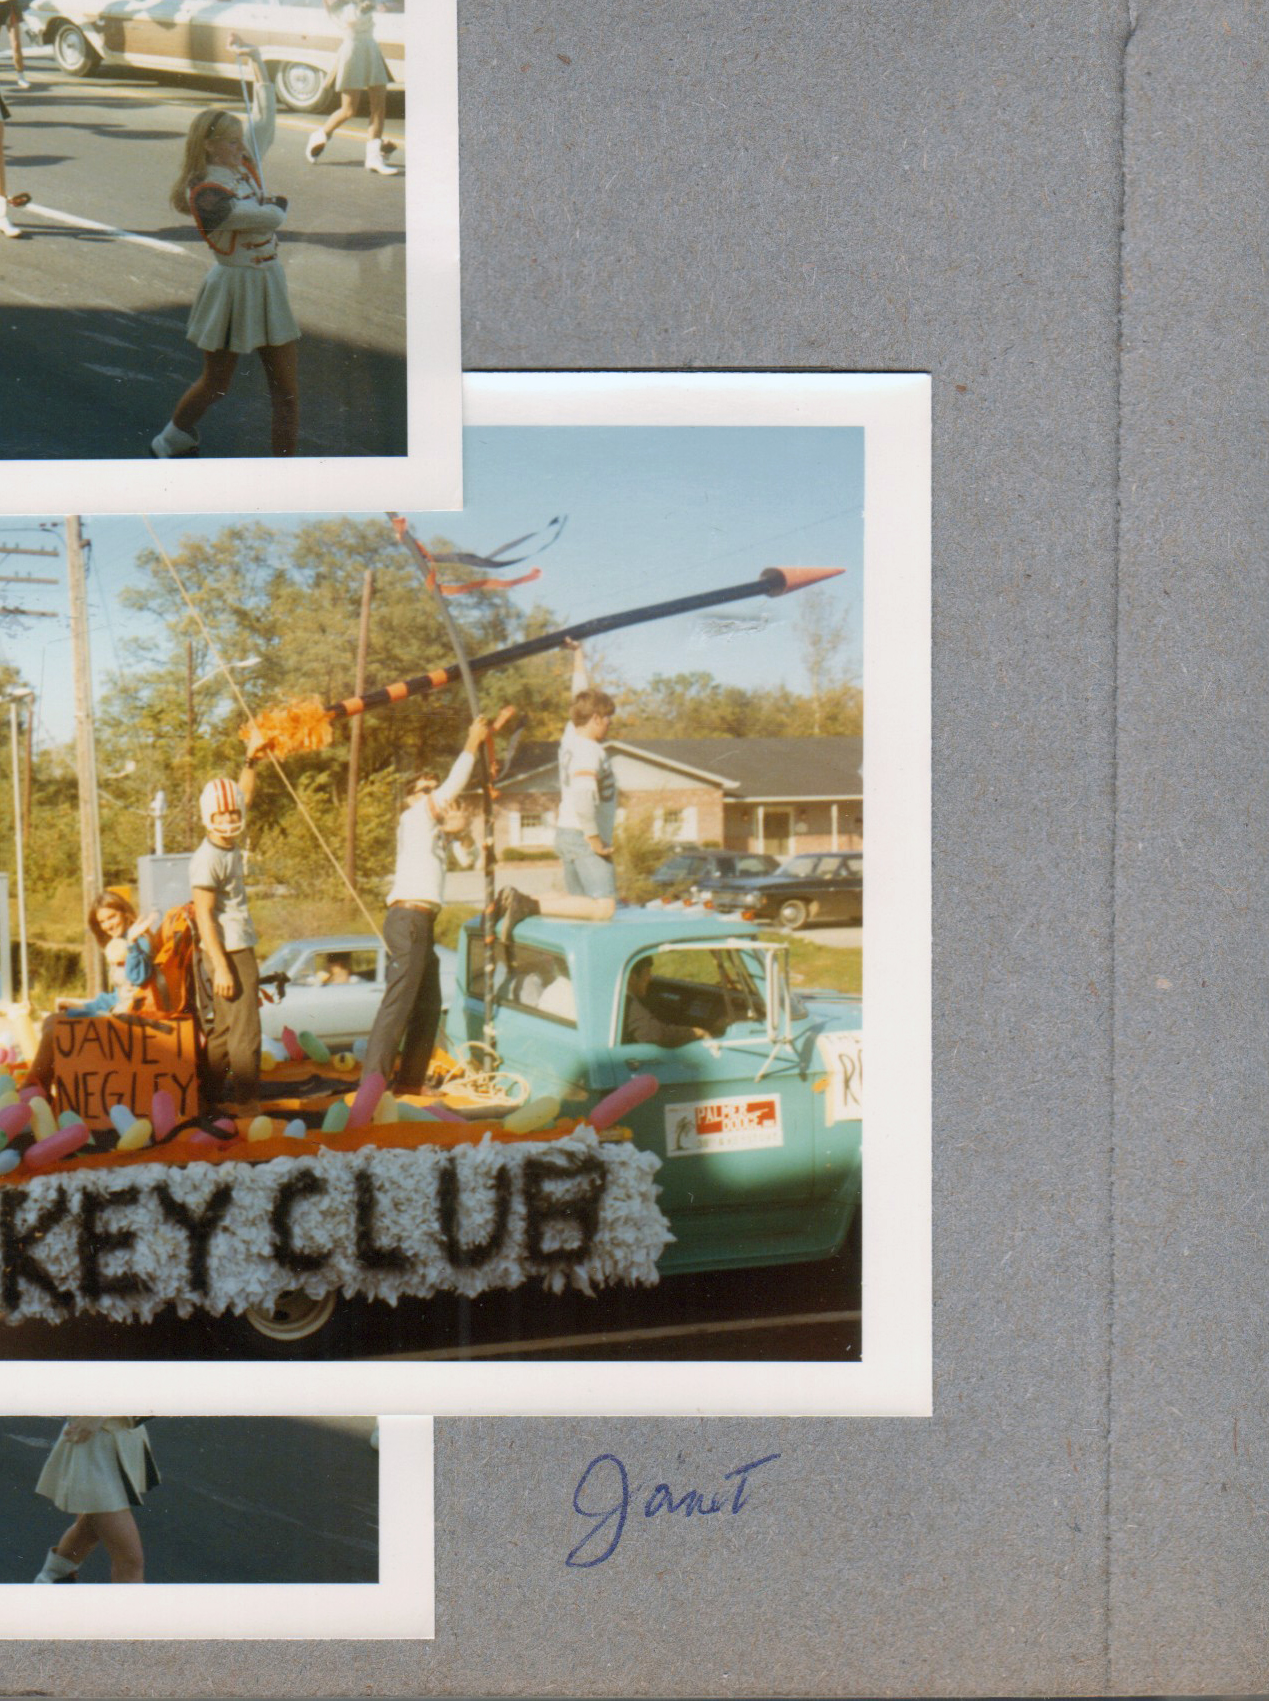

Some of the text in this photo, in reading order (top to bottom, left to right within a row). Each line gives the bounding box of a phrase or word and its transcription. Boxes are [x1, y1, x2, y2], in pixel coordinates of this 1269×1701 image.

[56, 1018, 191, 1065] JANET
[0, 1153, 606, 1313] KEY CLUB
